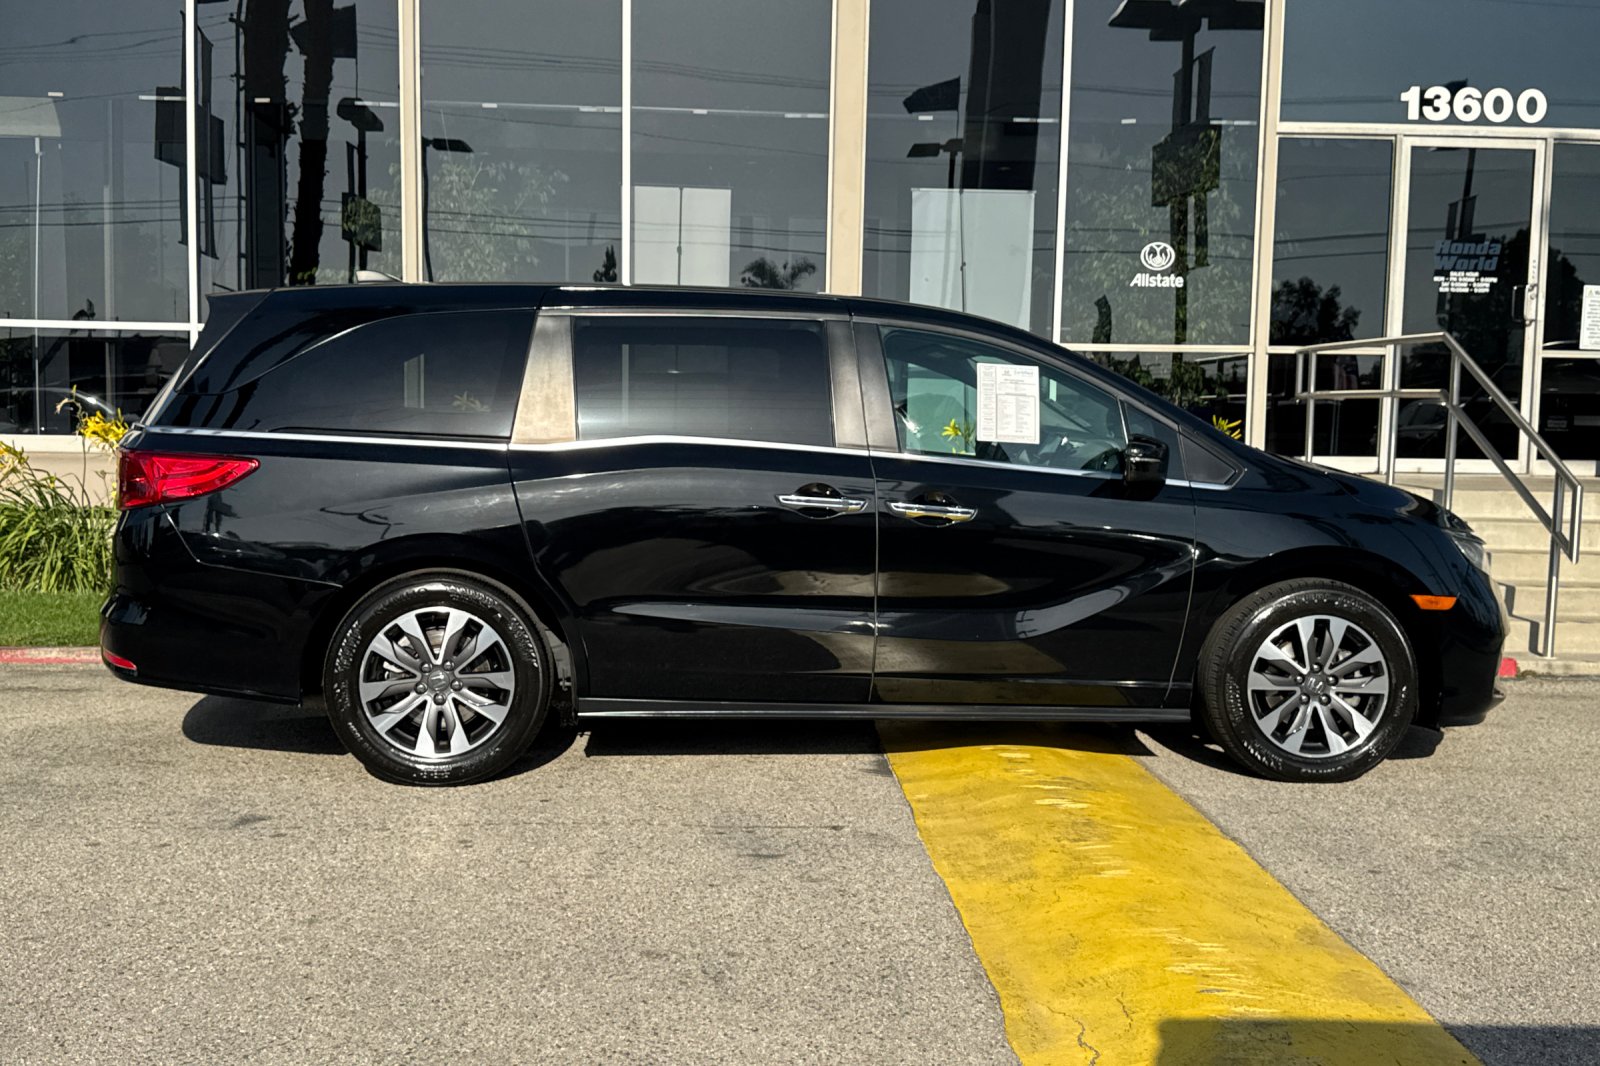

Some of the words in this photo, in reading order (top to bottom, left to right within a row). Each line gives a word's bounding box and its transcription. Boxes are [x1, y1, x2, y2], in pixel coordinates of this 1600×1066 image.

[1400, 85, 1548, 124] 13600
[1434, 240, 1502, 255] Honda
[1434, 255, 1499, 271] World
[1129, 272, 1185, 288] Allstate
